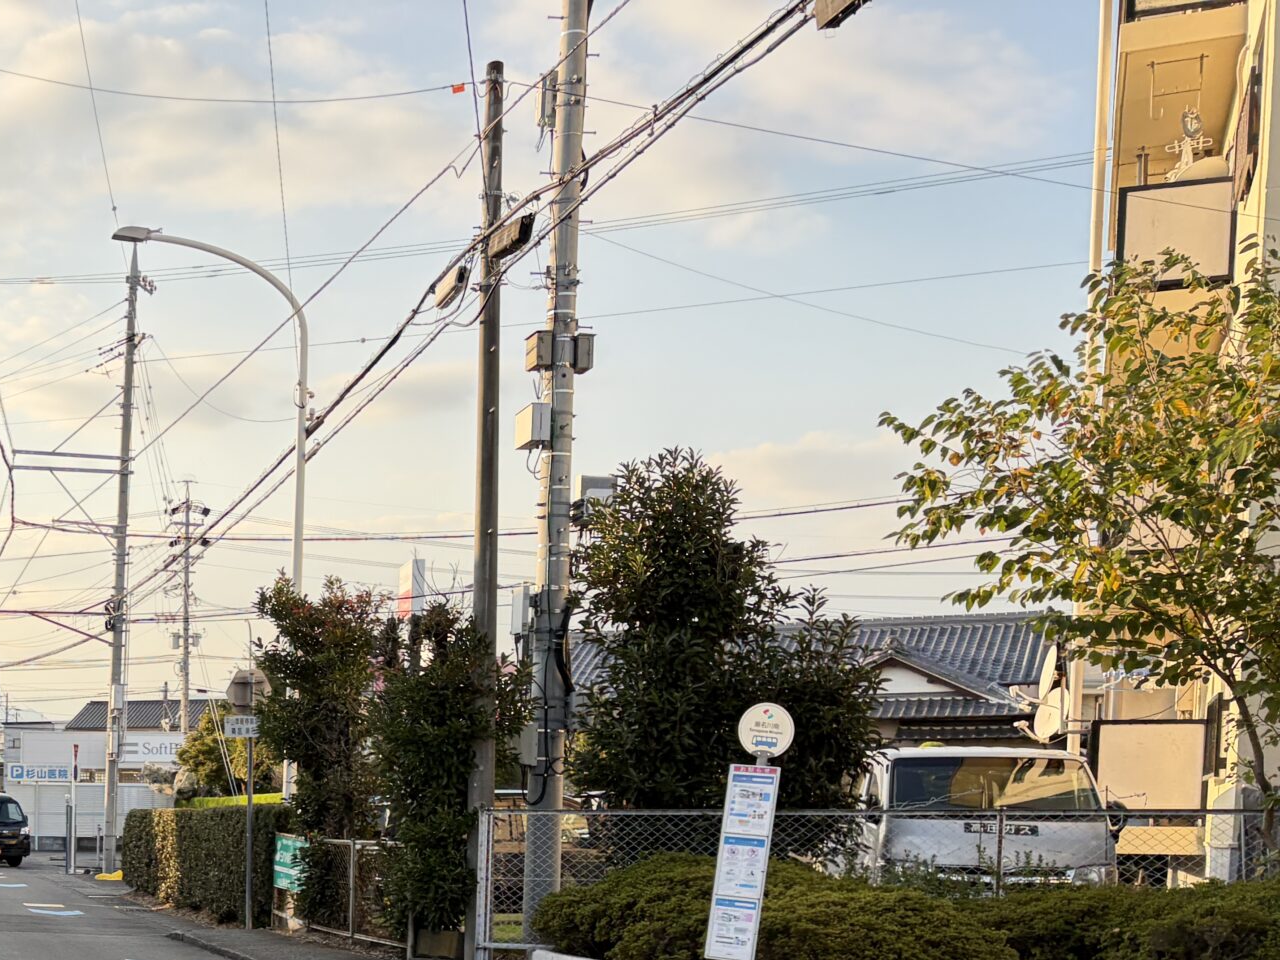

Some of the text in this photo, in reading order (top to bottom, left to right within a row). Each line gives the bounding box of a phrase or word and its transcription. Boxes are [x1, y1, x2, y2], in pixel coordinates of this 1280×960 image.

[142, 742, 182, 755] SoftB
[25, 768, 68, 780] 杉山医院
